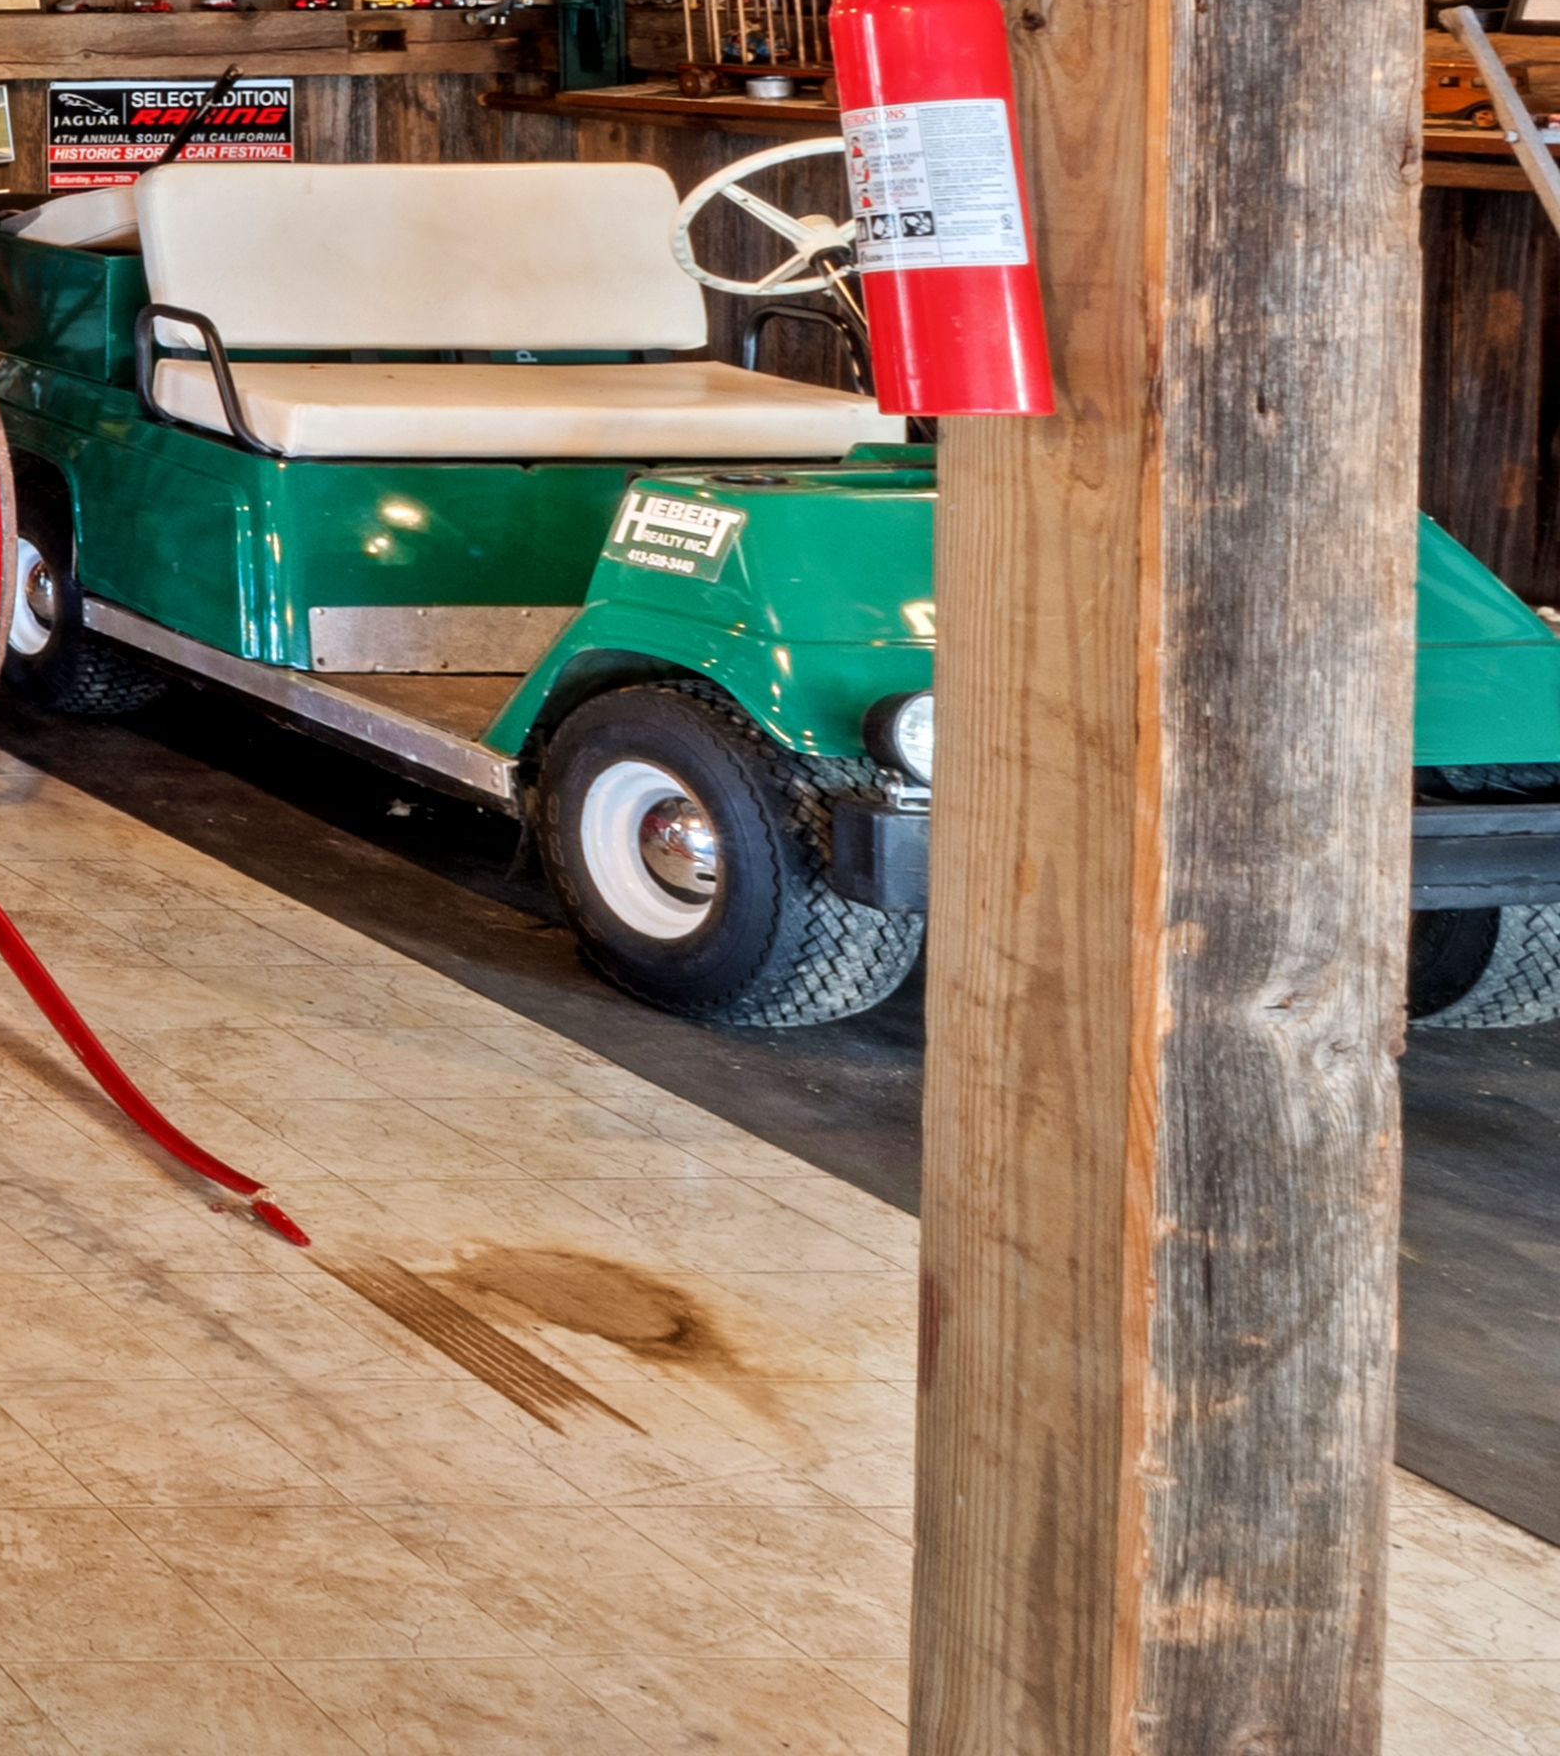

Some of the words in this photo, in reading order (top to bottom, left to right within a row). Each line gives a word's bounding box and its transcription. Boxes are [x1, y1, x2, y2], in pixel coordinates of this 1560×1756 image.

[131, 91, 205, 108] SELECT
[213, 90, 288, 107] DITION
[53, 115, 120, 128] JAGUAR
[53, 134, 78, 144] 4TH
[81, 134, 131, 144] ANNUAL
[209, 132, 287, 143] CALIFORNIA
[53, 147, 123, 161] HISTORIC
[185, 146, 217, 159] CAR
[219, 145, 288, 159] FESTIVAL
[93, 175, 113, 183] June
[613, 493, 743, 558] HEBERT
[641, 530, 683, 549] REALTY
